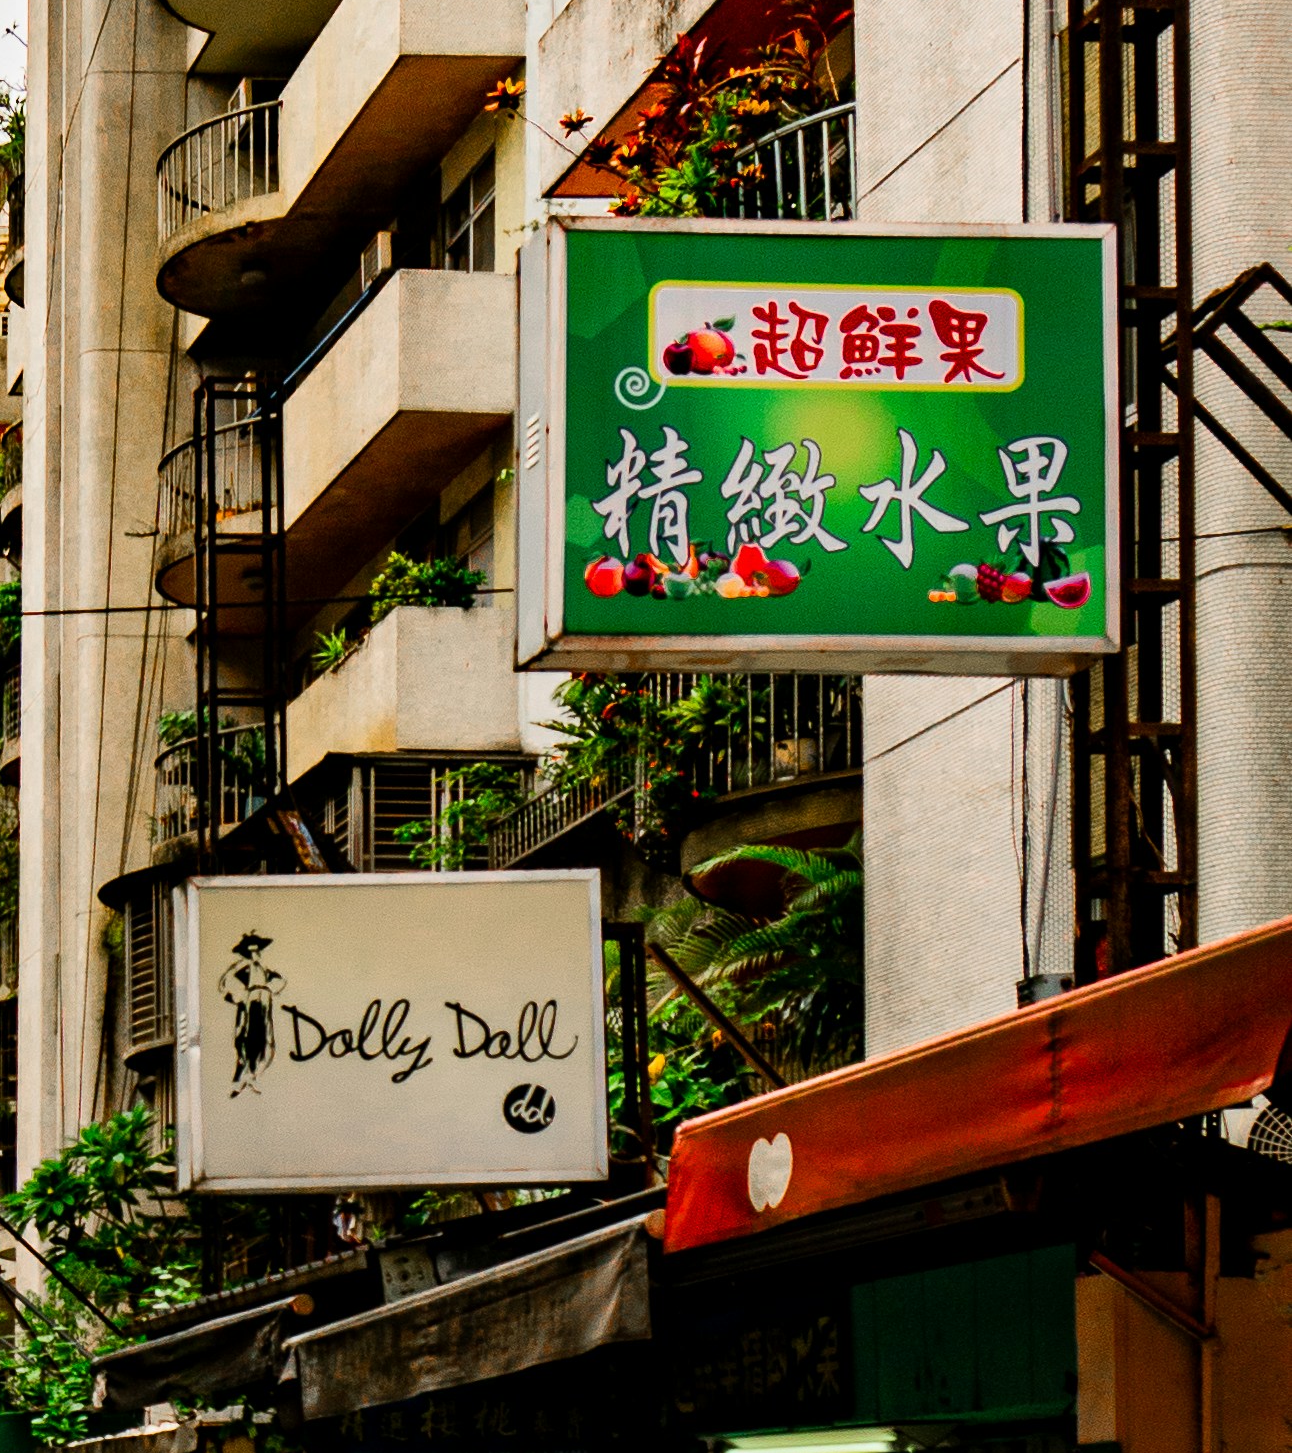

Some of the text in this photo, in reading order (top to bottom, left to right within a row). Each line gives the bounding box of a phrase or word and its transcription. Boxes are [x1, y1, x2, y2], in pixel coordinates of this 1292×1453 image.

[752, 299, 1006, 384] 超鮮果
[592, 426, 1083, 570] 精緻水果
[282, 998, 579, 1083] Dolly Doll
